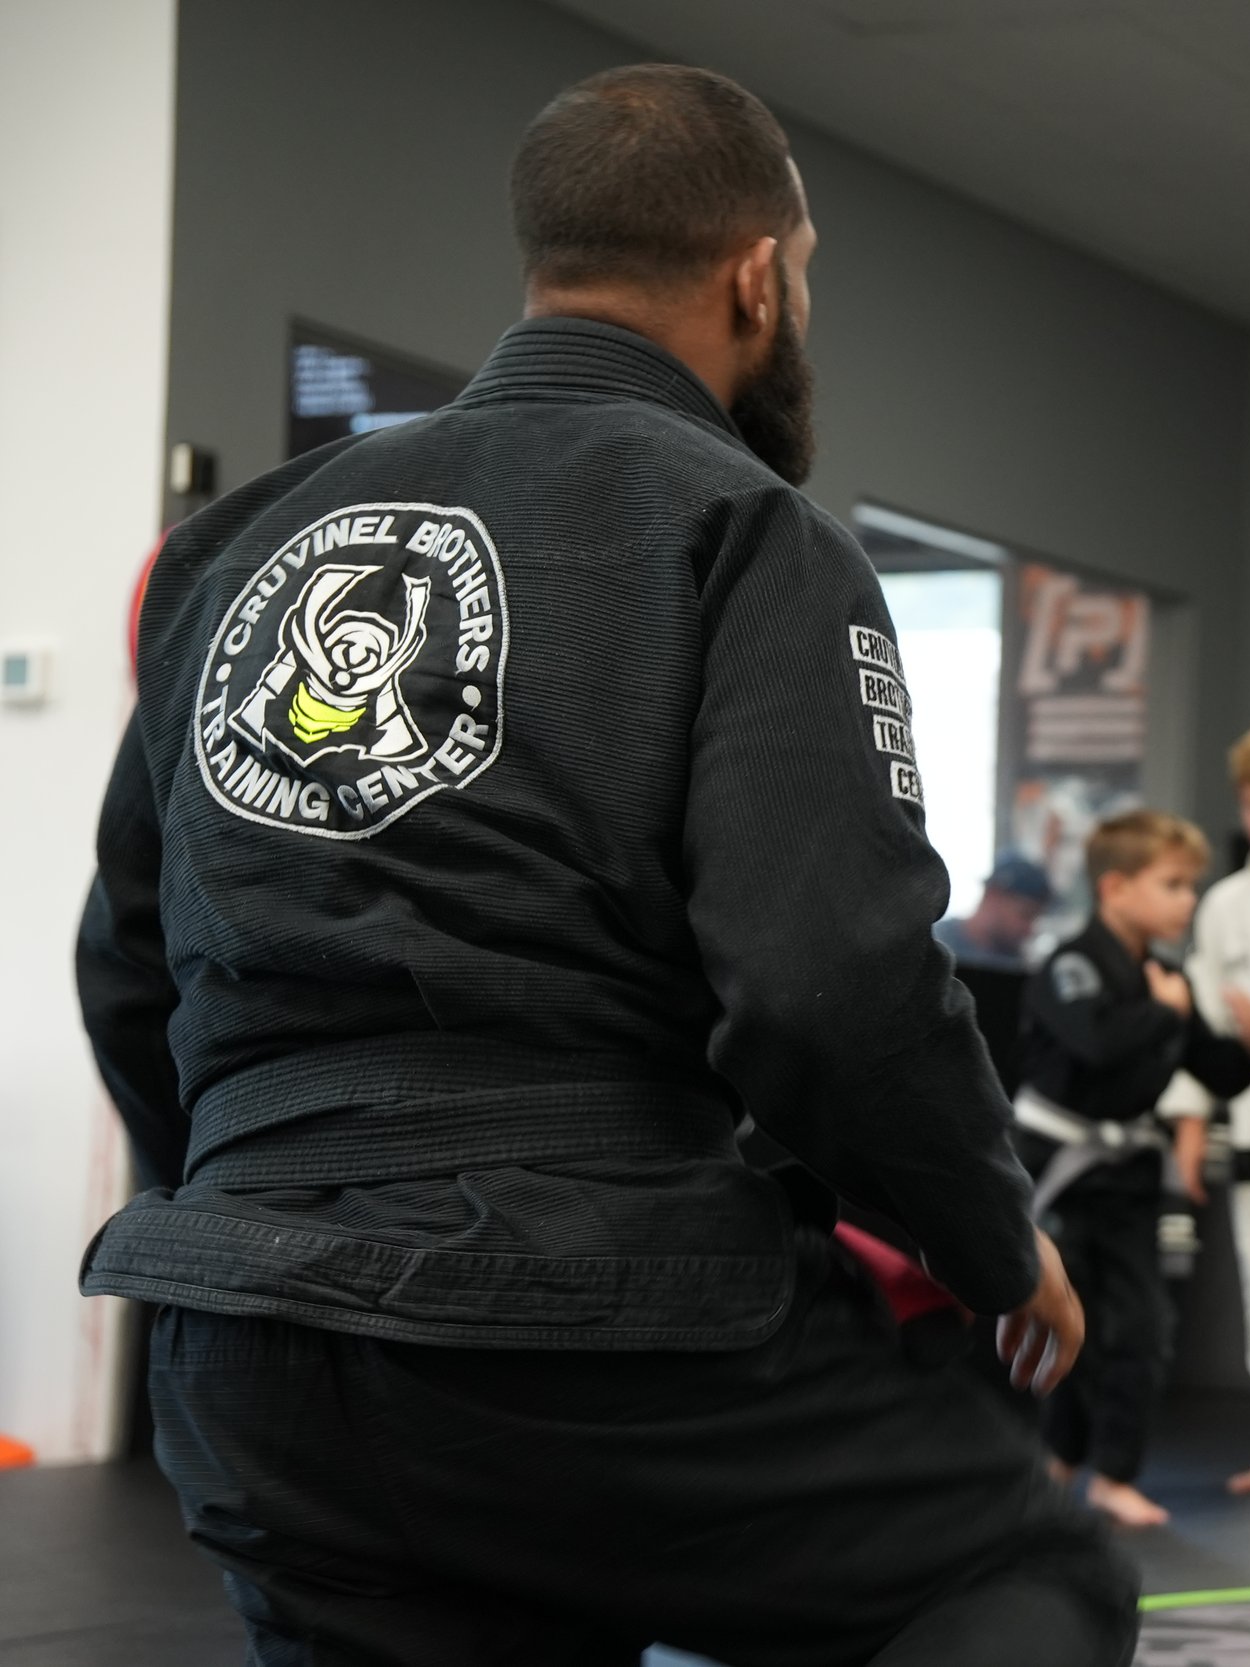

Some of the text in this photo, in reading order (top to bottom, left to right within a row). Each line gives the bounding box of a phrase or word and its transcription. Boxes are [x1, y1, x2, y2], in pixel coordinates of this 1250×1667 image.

[224, 516, 493, 674] CRUVINEL BROTHERS
[201, 686, 489, 821] TRAINING CENTER
